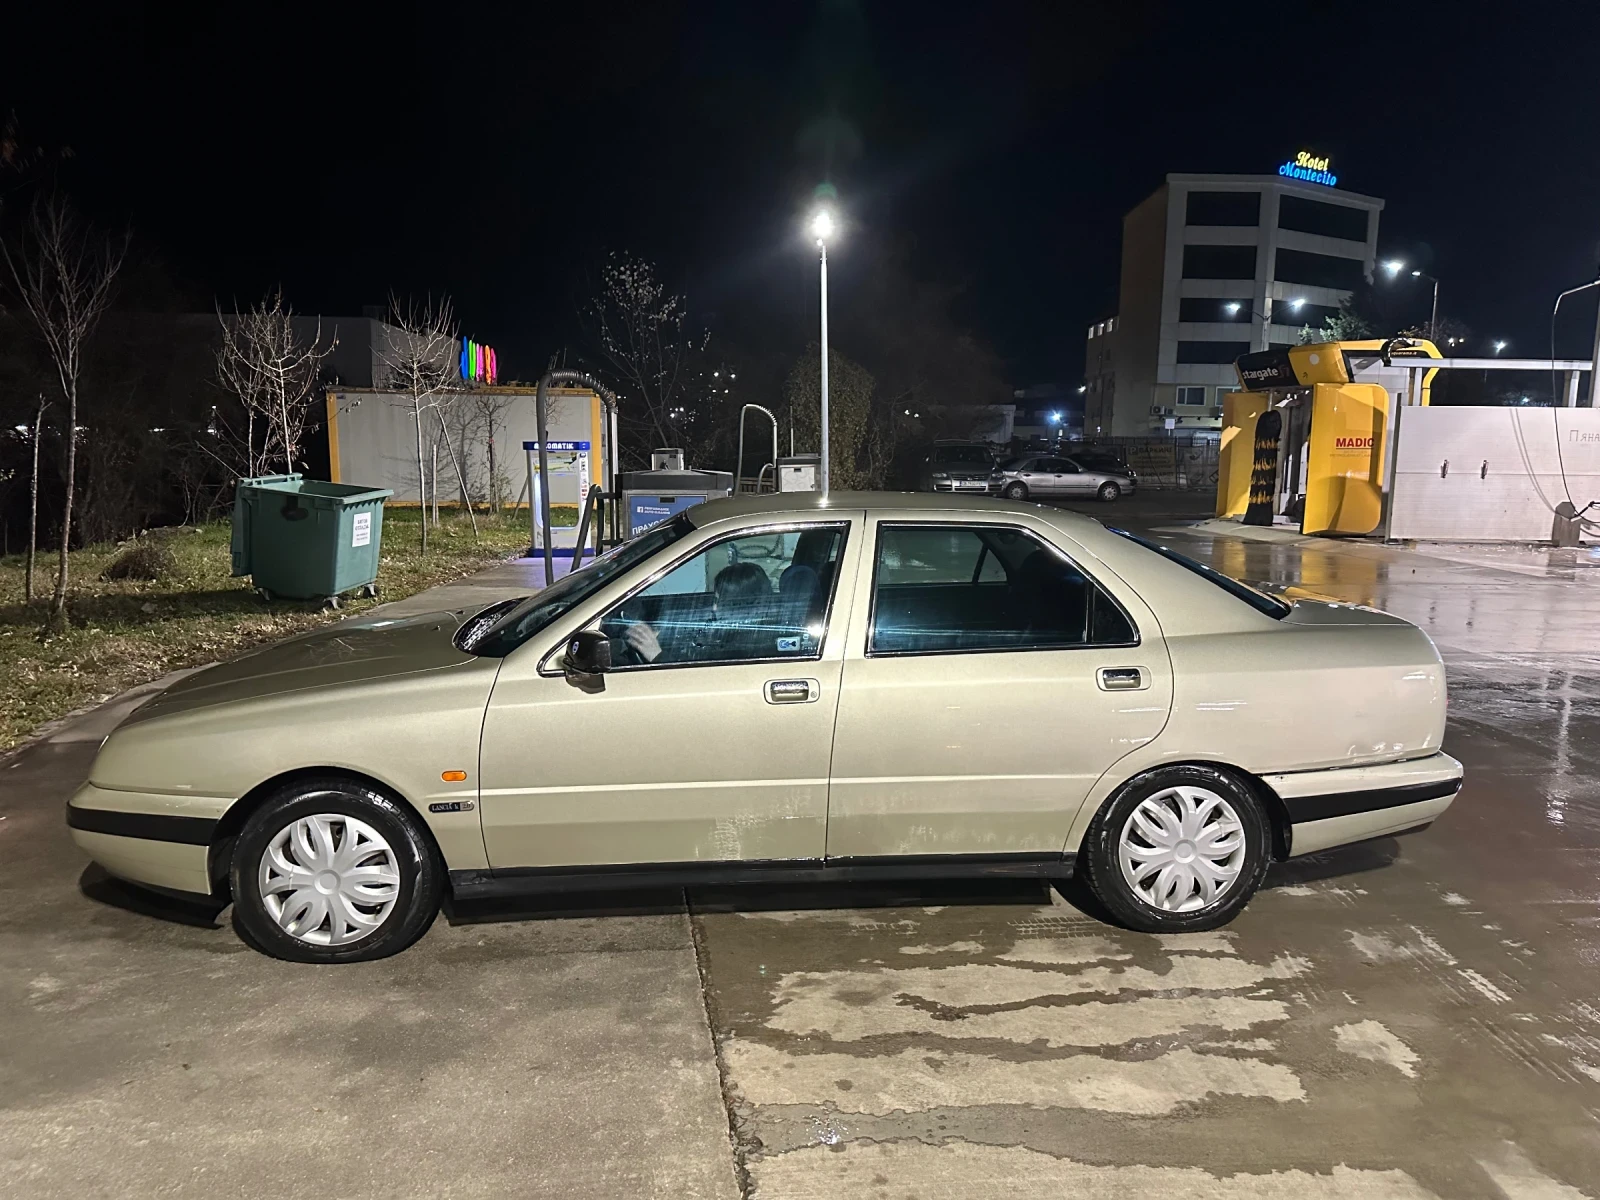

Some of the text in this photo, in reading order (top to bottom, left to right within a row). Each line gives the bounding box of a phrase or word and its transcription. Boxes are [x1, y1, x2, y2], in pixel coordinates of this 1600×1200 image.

[1296, 151, 1329, 171] Hotel
[1279, 161, 1337, 186] Montecito
[1242, 367, 1279, 380] stargate
[533, 442, 574, 450] AOMATIK
[1336, 438, 1375, 448] MADIC
[431, 802, 453, 811] LANCIA
